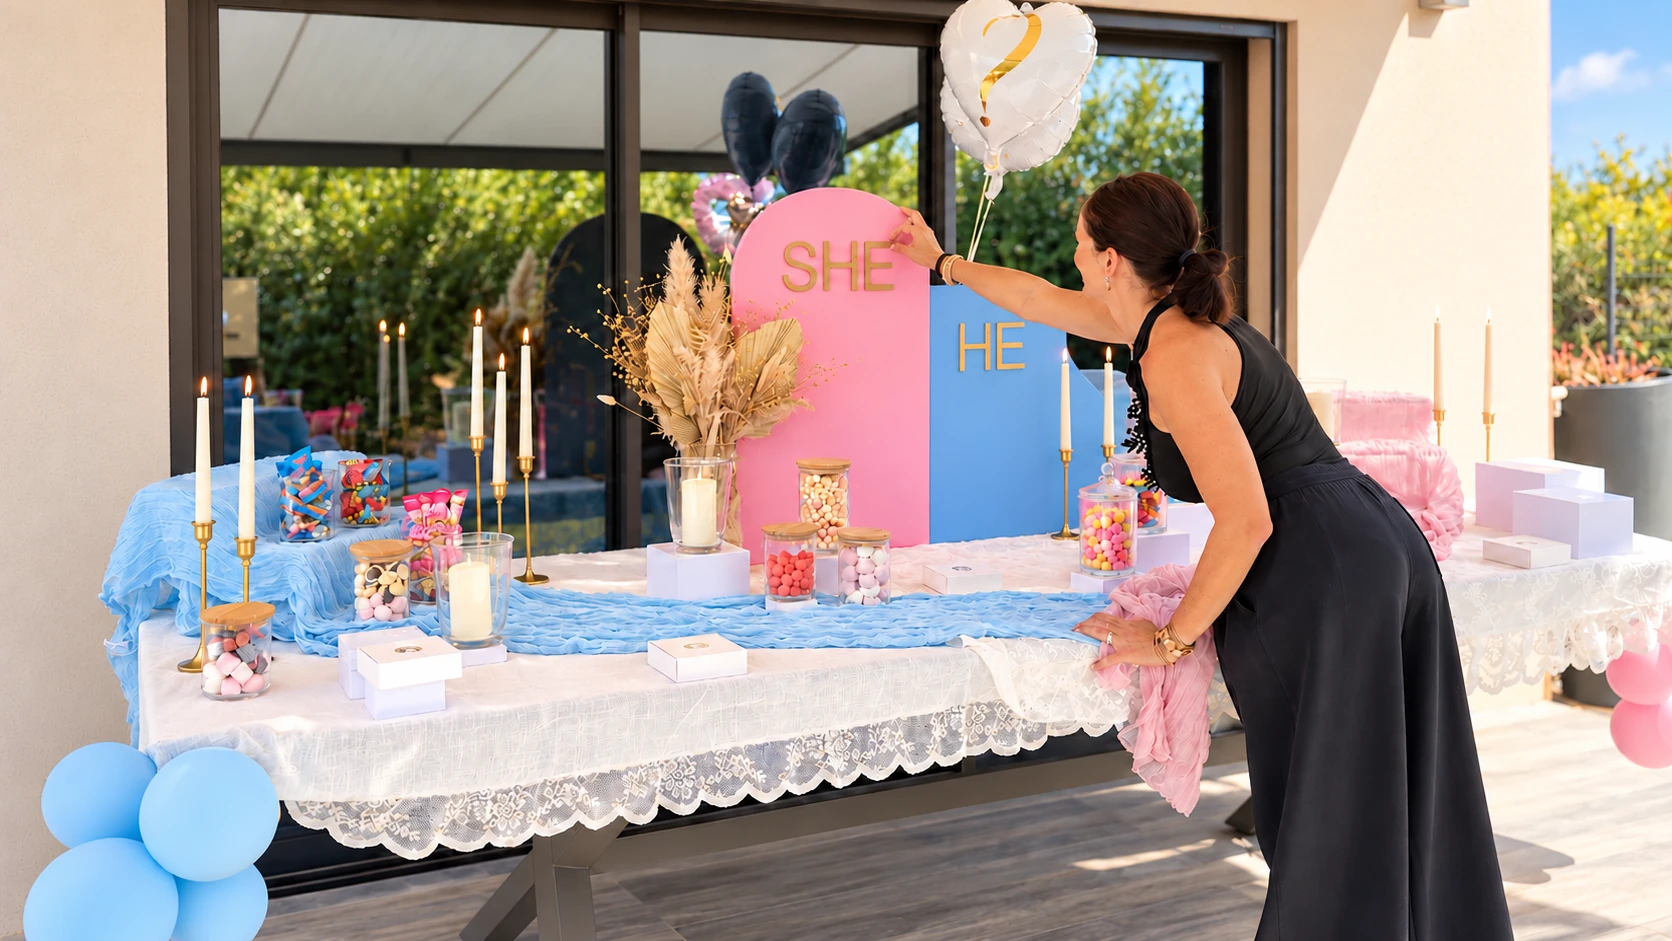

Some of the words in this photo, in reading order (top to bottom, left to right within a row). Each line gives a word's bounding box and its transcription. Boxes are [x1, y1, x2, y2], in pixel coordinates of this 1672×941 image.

[980, 13, 1042, 127] ?
[782, 241, 894, 292] SHE
[959, 321, 1025, 372] HE
